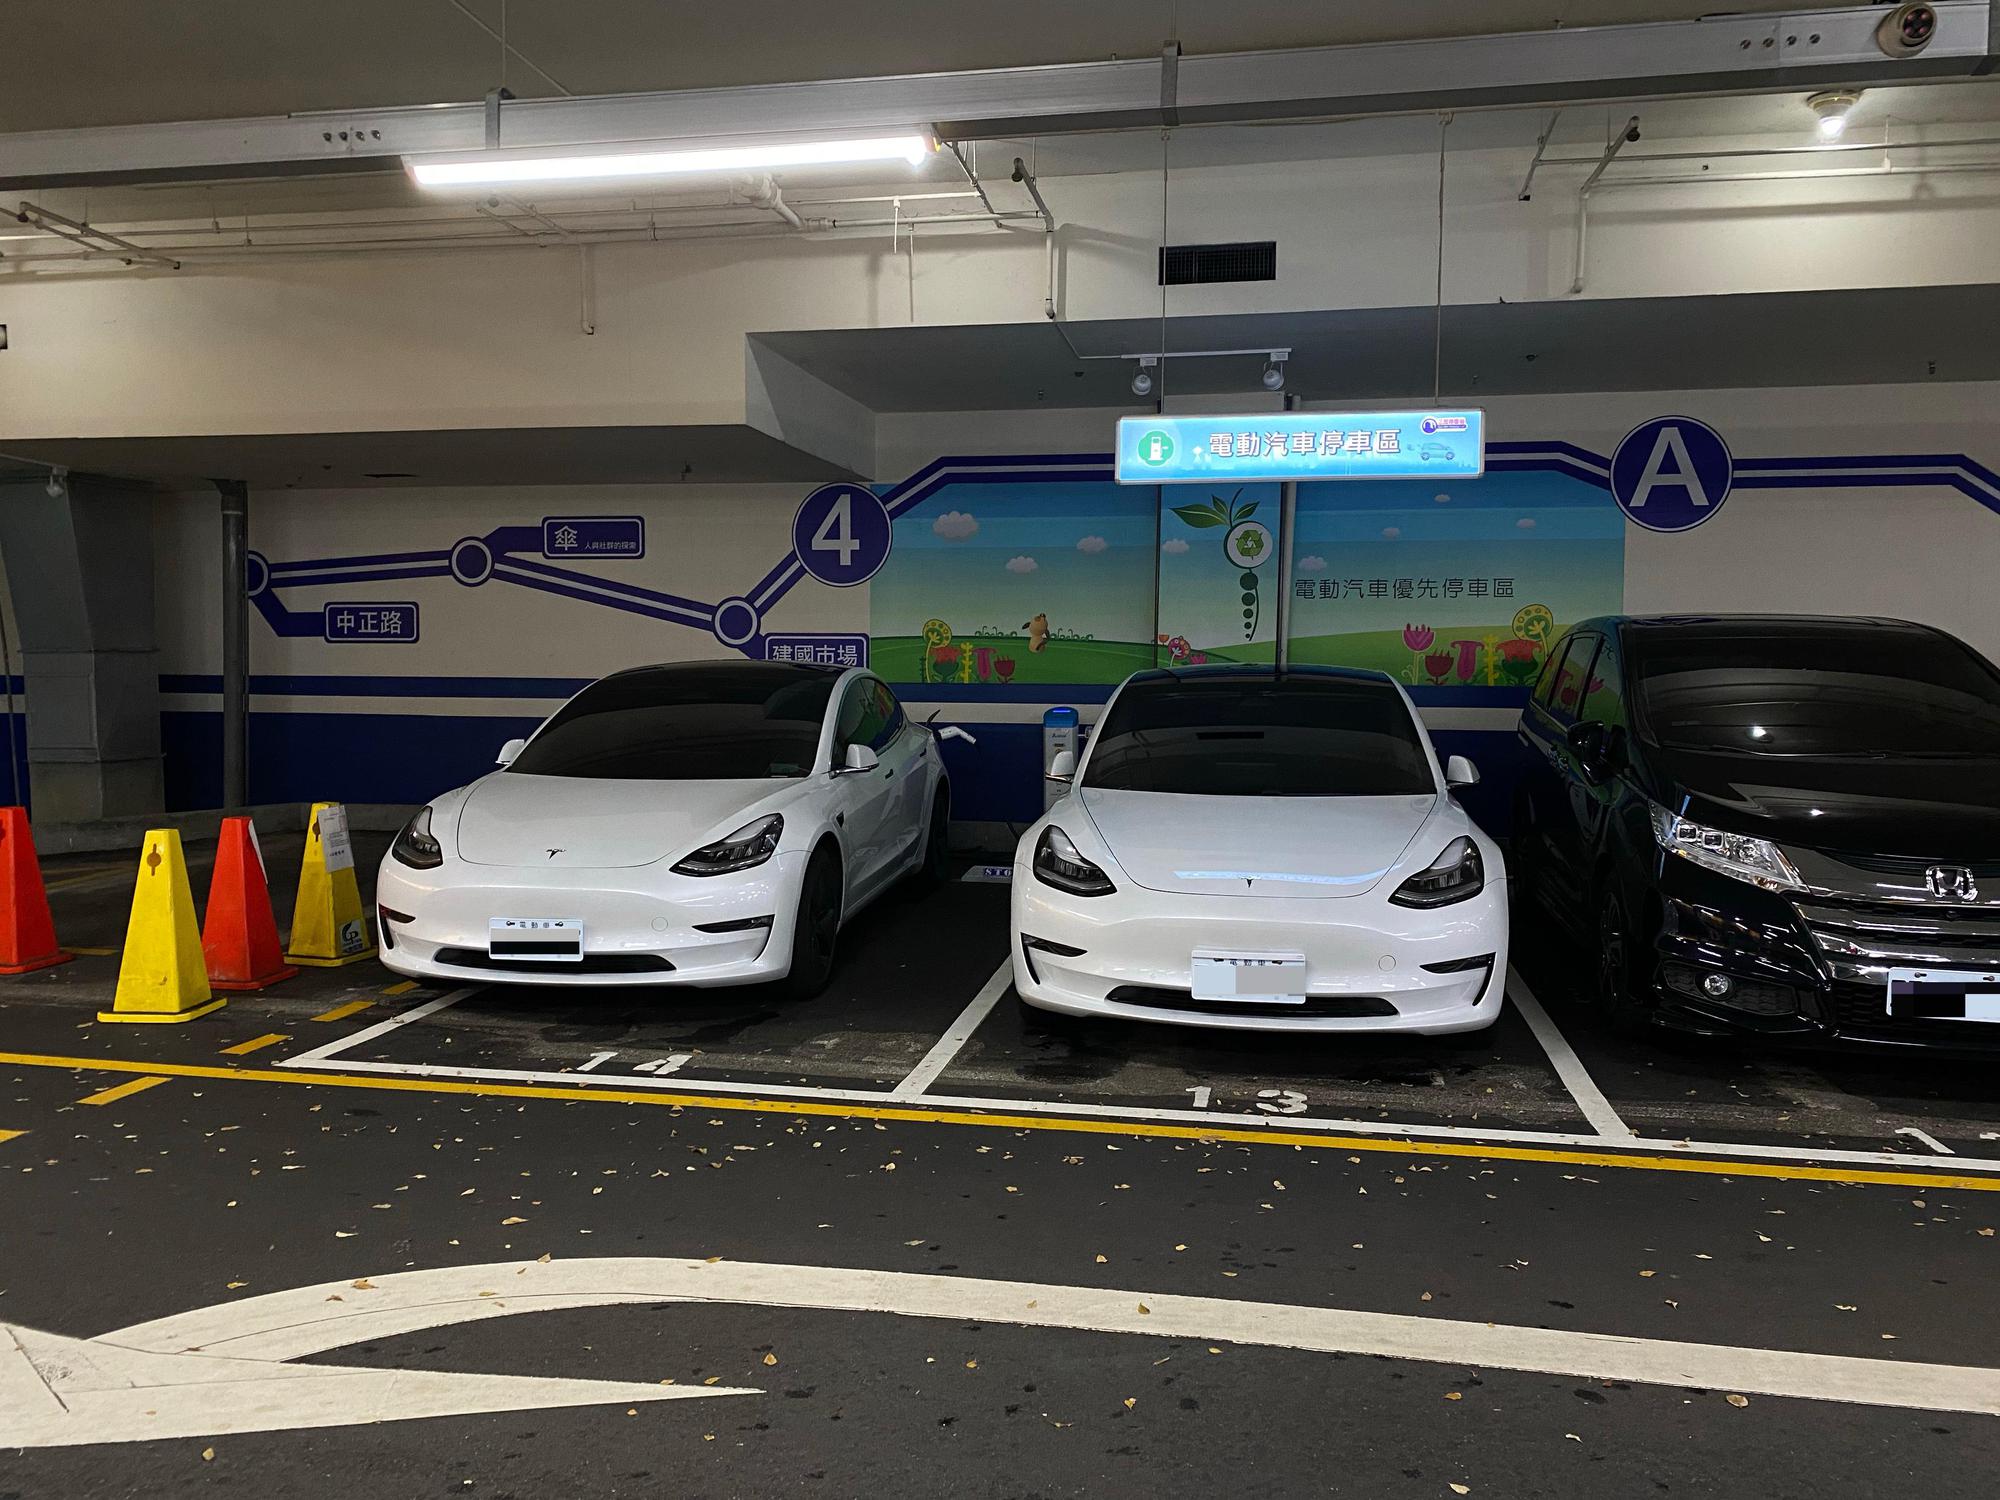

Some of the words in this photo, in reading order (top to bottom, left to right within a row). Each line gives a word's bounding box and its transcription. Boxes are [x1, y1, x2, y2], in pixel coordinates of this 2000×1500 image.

[1209, 429, 1401, 457] 電動汽車停車區
[1629, 427, 1709, 507] A
[555, 525, 578, 551] 傘
[812, 494, 859, 565] 4
[1295, 578, 1515, 600] 電動汽車優先停車區
[337, 610, 402, 635] 中正路
[772, 644, 858, 666] 建國市場
[985, 868, 1012, 878] STO
[1186, 1086, 1308, 1114] 13
